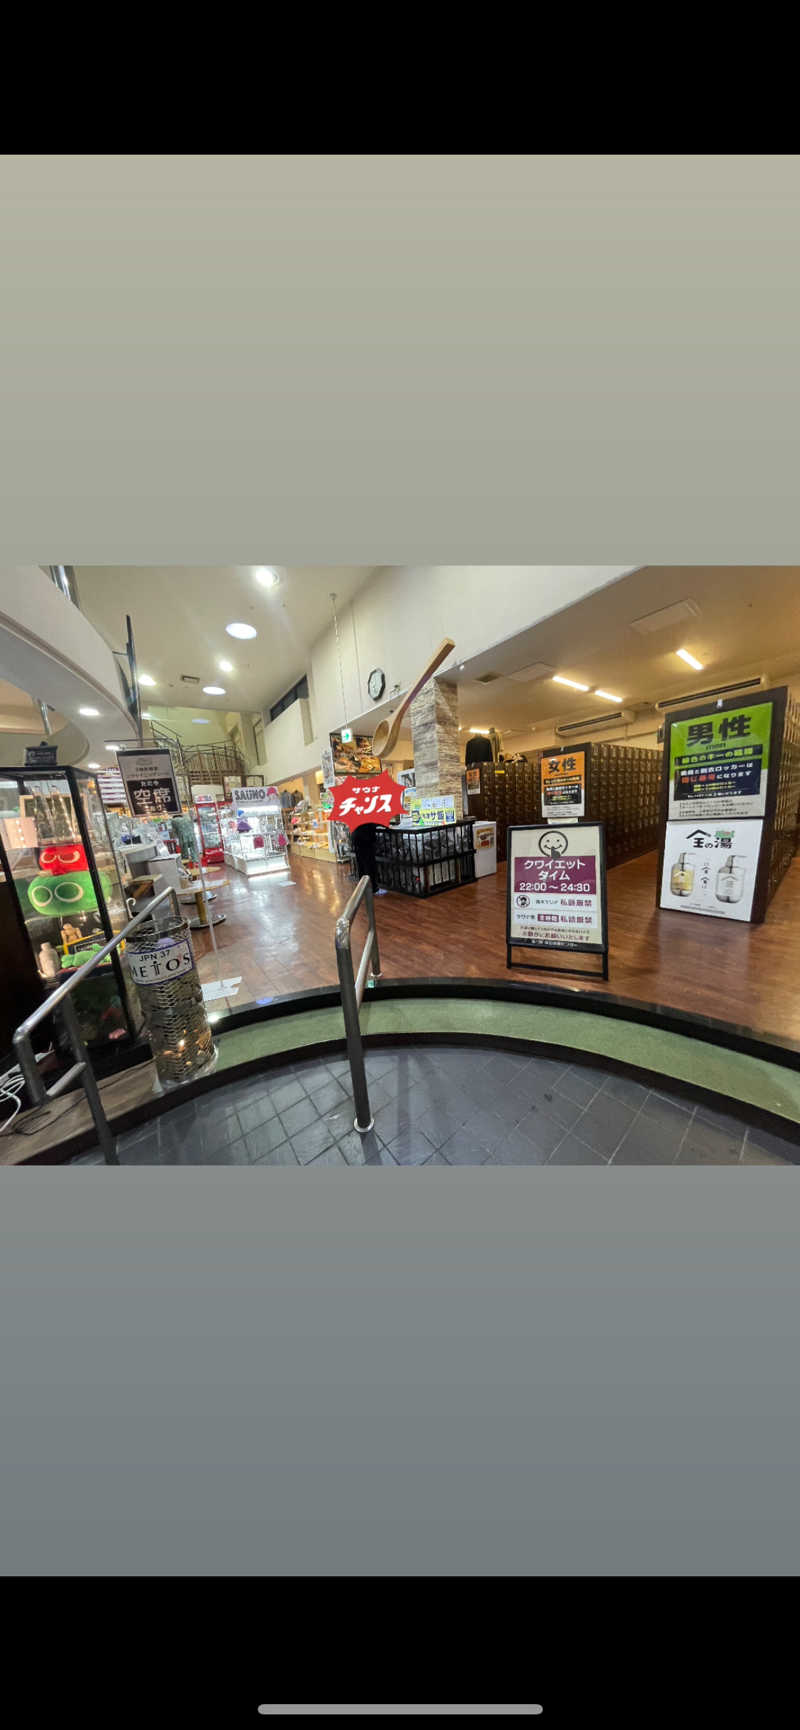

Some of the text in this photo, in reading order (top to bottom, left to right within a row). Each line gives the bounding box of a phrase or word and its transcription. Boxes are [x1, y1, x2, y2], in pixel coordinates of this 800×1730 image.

[687, 714, 751, 747] 男性
[548, 757, 576, 773] 女性
[133, 787, 171, 804] 空席
[524, 859, 586, 869] クワイエット
[538, 870, 570, 881] タイム
[519, 882, 547, 892] 22:00
[560, 883, 590, 892] 24:30
[161, 950, 170, 958] 37
